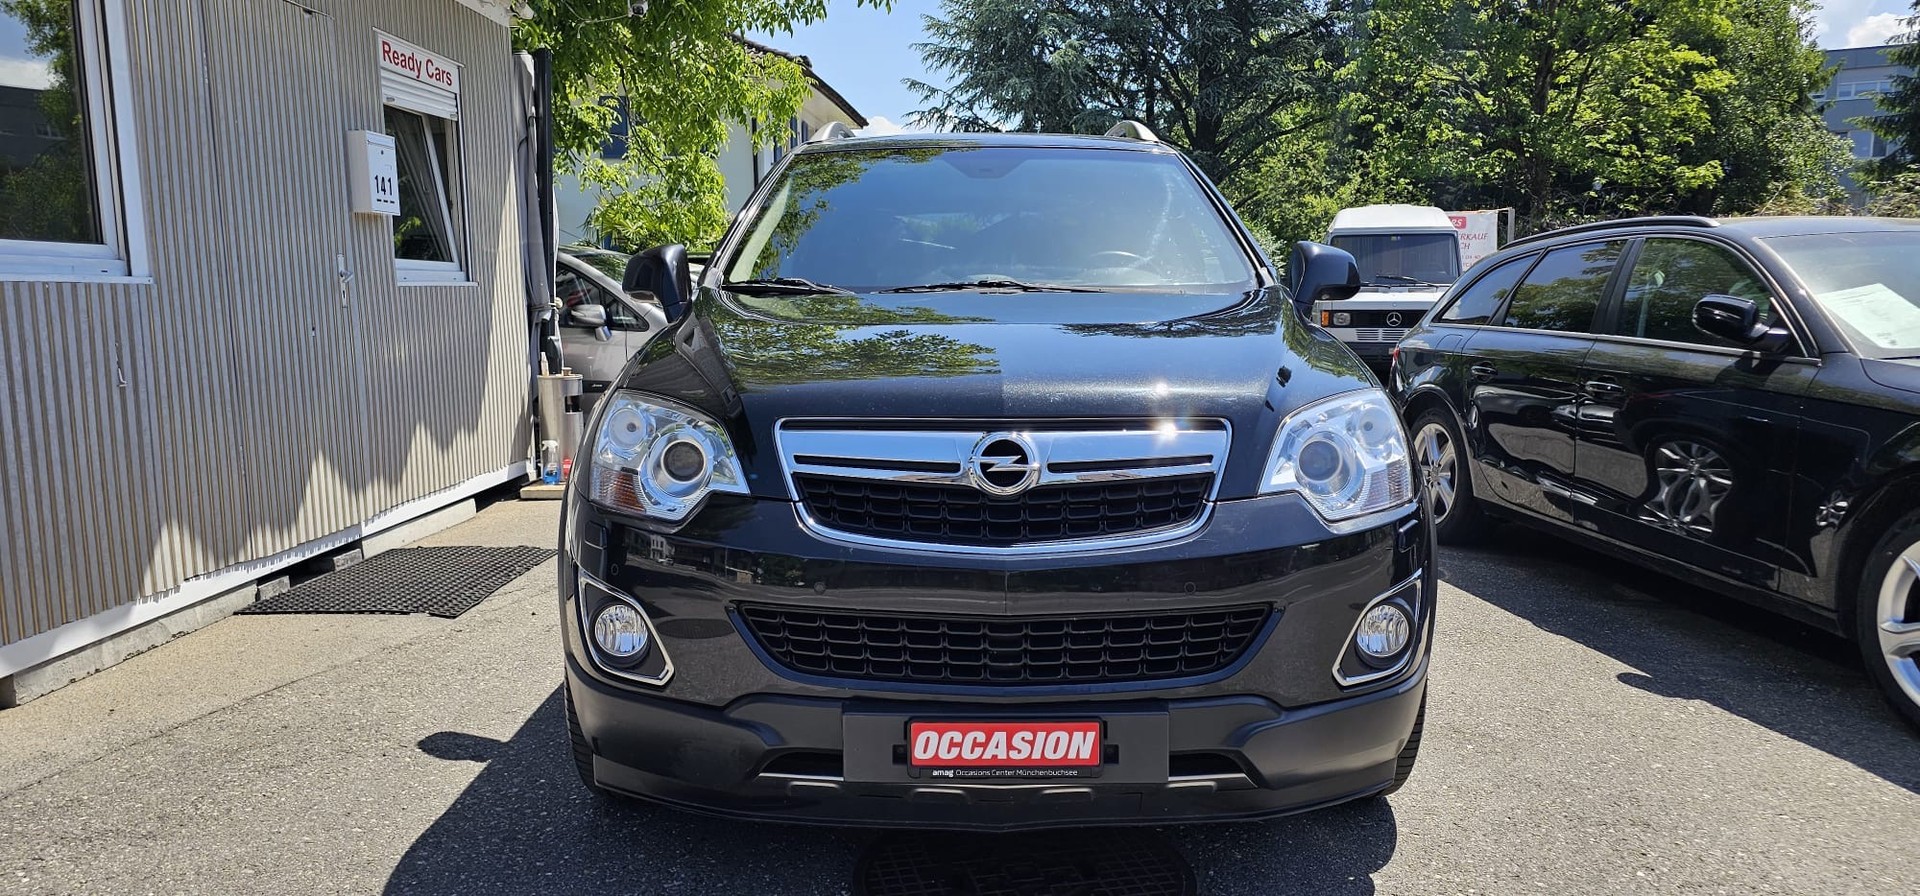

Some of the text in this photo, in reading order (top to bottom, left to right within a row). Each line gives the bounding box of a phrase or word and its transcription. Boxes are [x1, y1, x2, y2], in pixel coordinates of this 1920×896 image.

[381, 40, 453, 87] Ready Cars
[374, 174, 394, 196] 141
[913, 731, 1096, 760] OCCASION
[932, 767, 1078, 778] amag Occasions Center Münchenbuchsee
